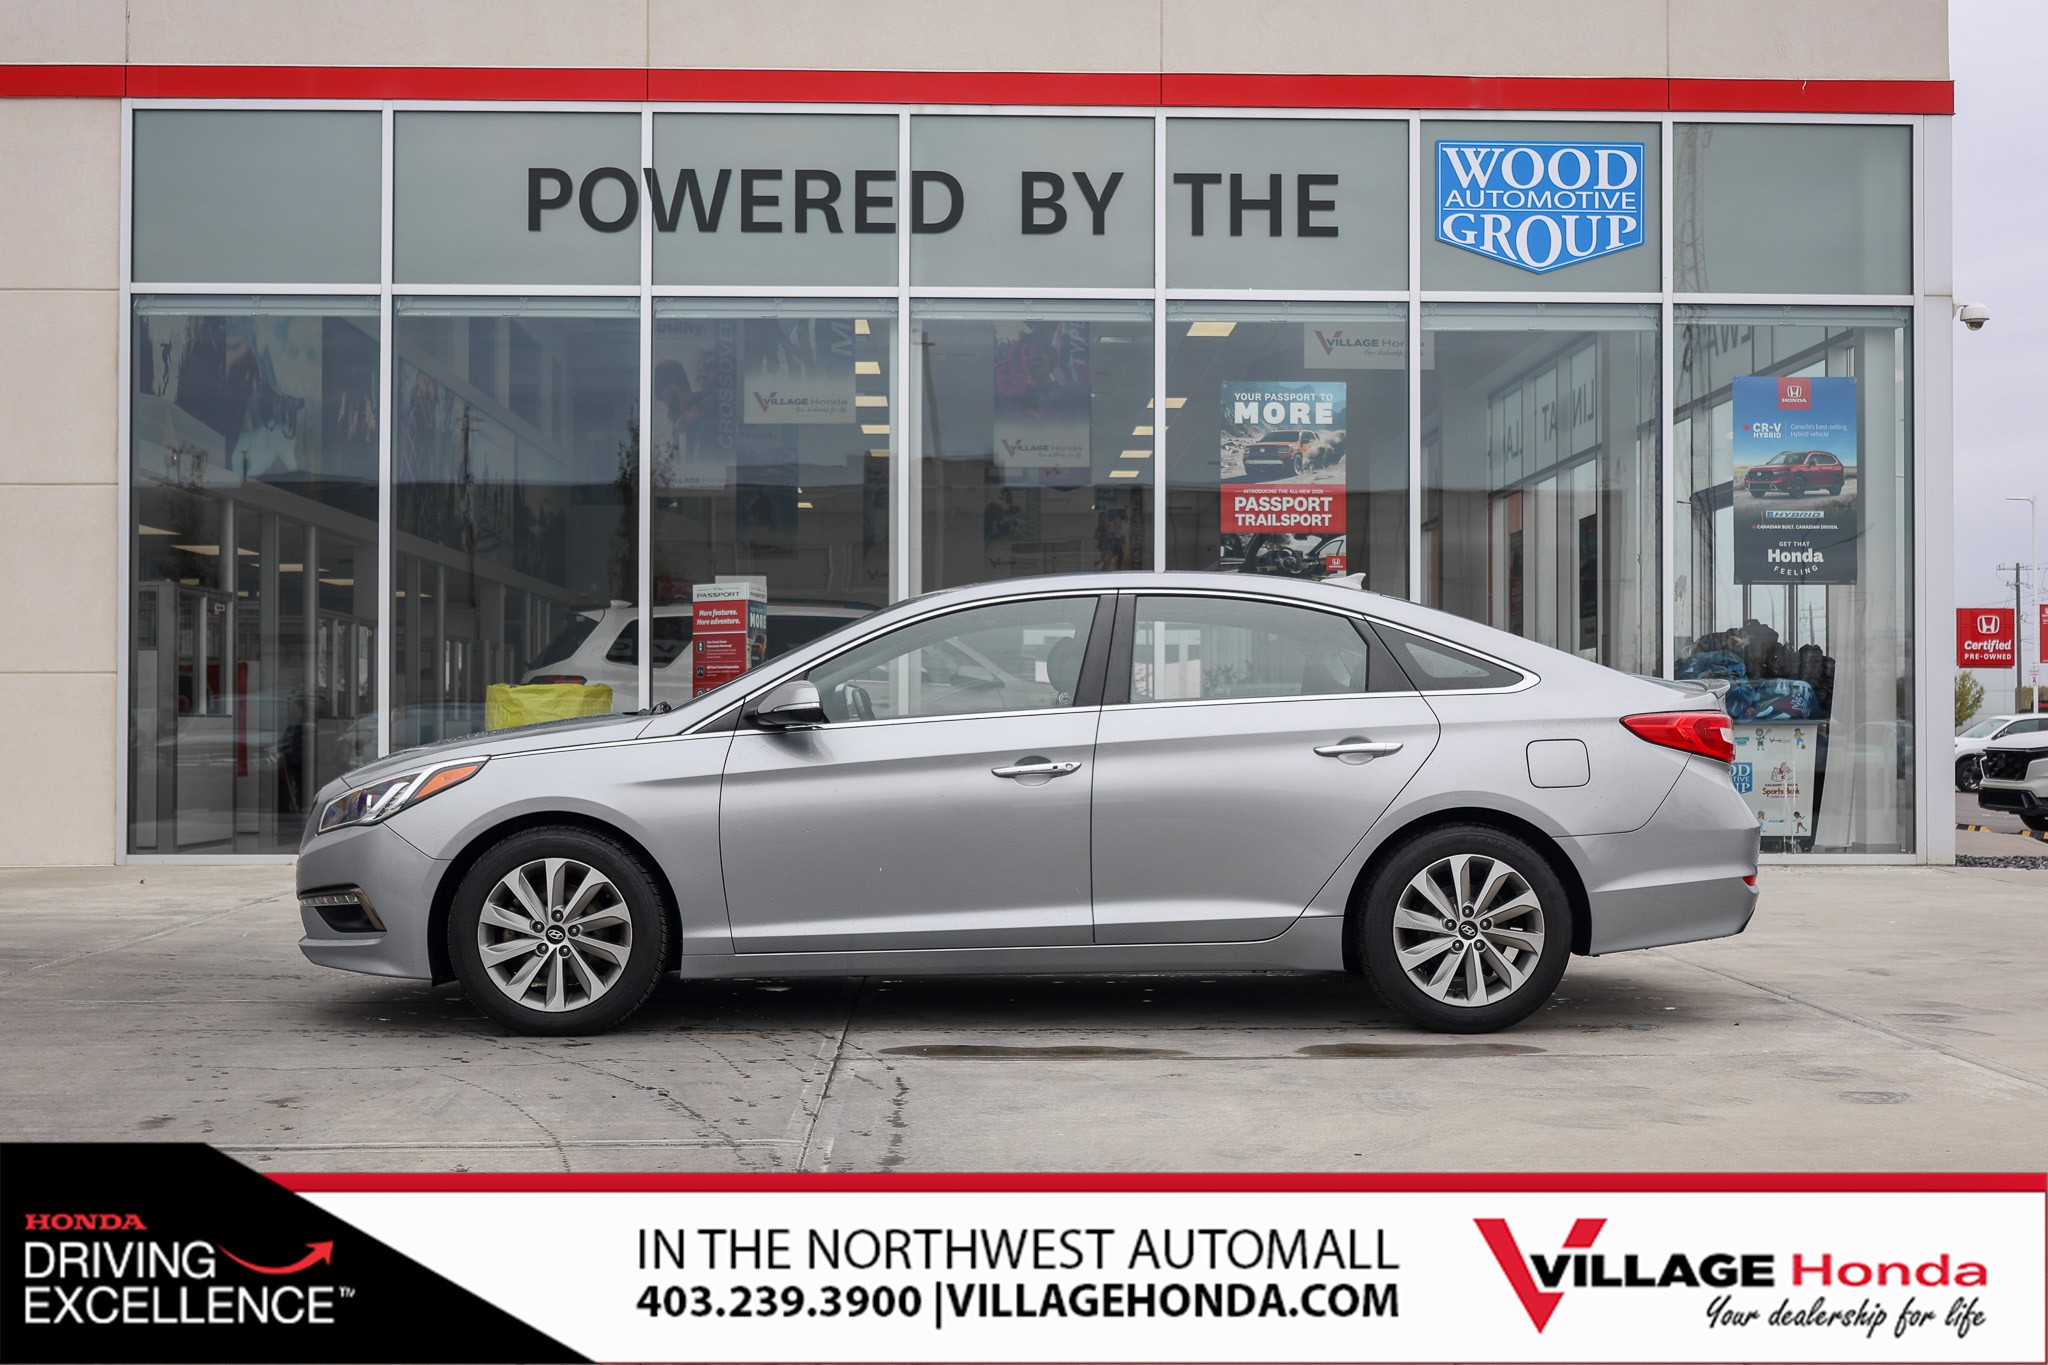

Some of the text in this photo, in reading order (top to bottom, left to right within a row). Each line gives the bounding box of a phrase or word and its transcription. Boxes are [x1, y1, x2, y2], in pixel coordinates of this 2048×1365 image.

[1442, 147, 1638, 190] WOOD
[528, 167, 1339, 237] POWERED BY THE
[1444, 189, 1636, 210] AUTOMOTIVE
[1442, 212, 1638, 268] GROUP
[810, 398, 848, 406] Honda
[1233, 392, 1333, 402] YOUR PASSPORT TO
[1234, 402, 1333, 425] MORE
[1752, 422, 1782, 432] CR-V
[1815, 423, 1848, 431] best-selling
[1234, 496, 1333, 512] PASSPORT
[1235, 513, 1332, 527] TRAILSPORT
[1767, 548, 1824, 563] Honda
[1773, 565, 1818, 576] FEELING
[696, 591, 741, 599] PASSPORT
[698, 609, 738, 618] More features.
[696, 617, 741, 626] More adventure.
[1964, 639, 2012, 652] Certified
[1762, 787, 1784, 797] Sports
